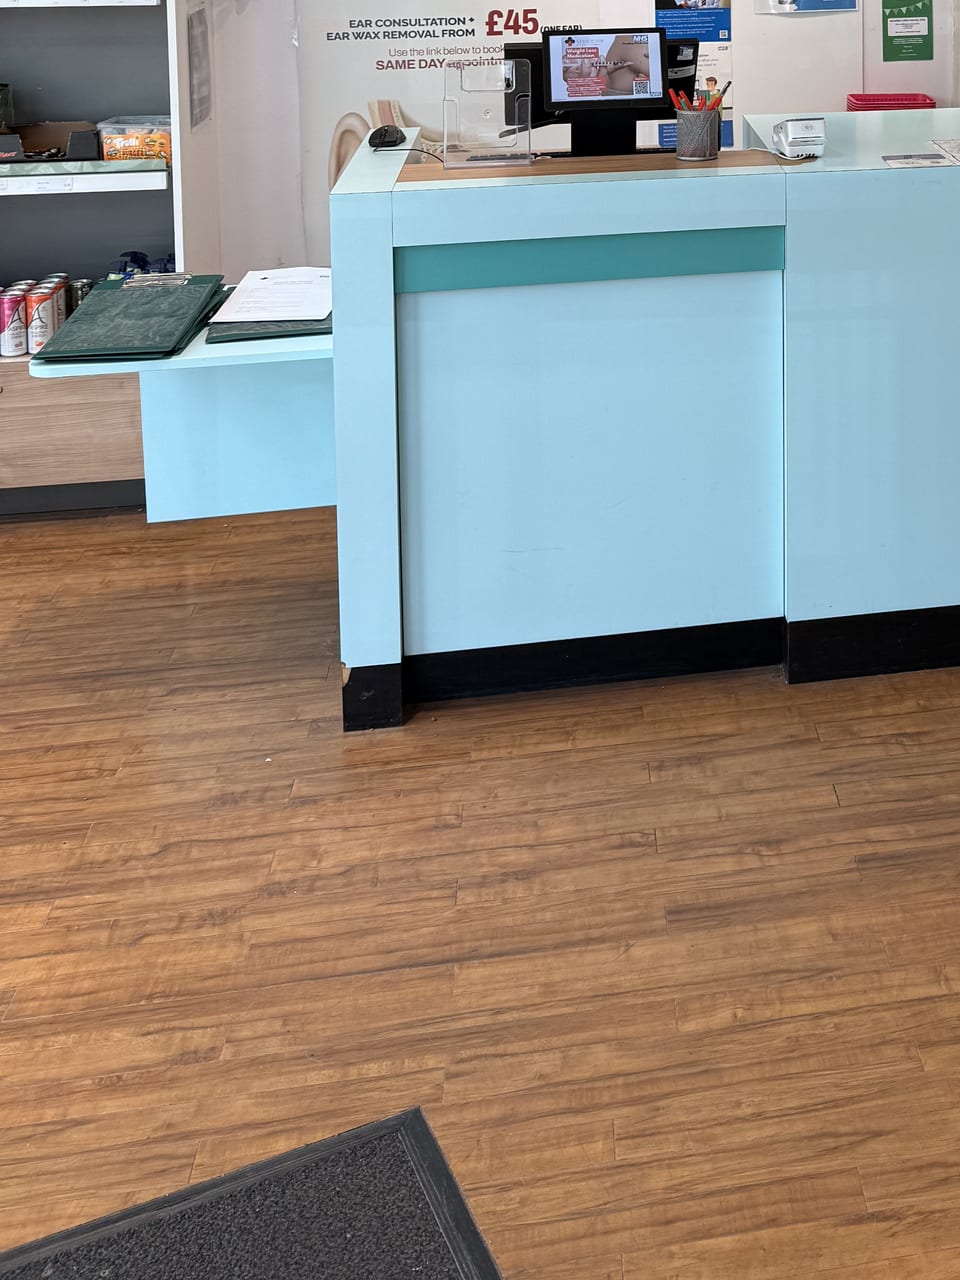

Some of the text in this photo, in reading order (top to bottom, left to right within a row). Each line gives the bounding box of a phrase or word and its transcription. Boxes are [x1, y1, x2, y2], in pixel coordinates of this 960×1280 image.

[349, 20, 373, 28] EAR
[375, 17, 466, 28] CONSULTATION
[485, 8, 539, 37] £45
[326, 28, 475, 41] EAR WAX REMOVAL FROM
[389, 48, 408, 57] Use
[410, 48, 424, 56] the
[426, 47, 441, 56] link
[443, 46, 471, 55] below
[472, 46, 481, 54] to
[376, 59, 416, 70] SAME
[418, 58, 446, 69] DAY
[115, 137, 139, 148] Trolli
